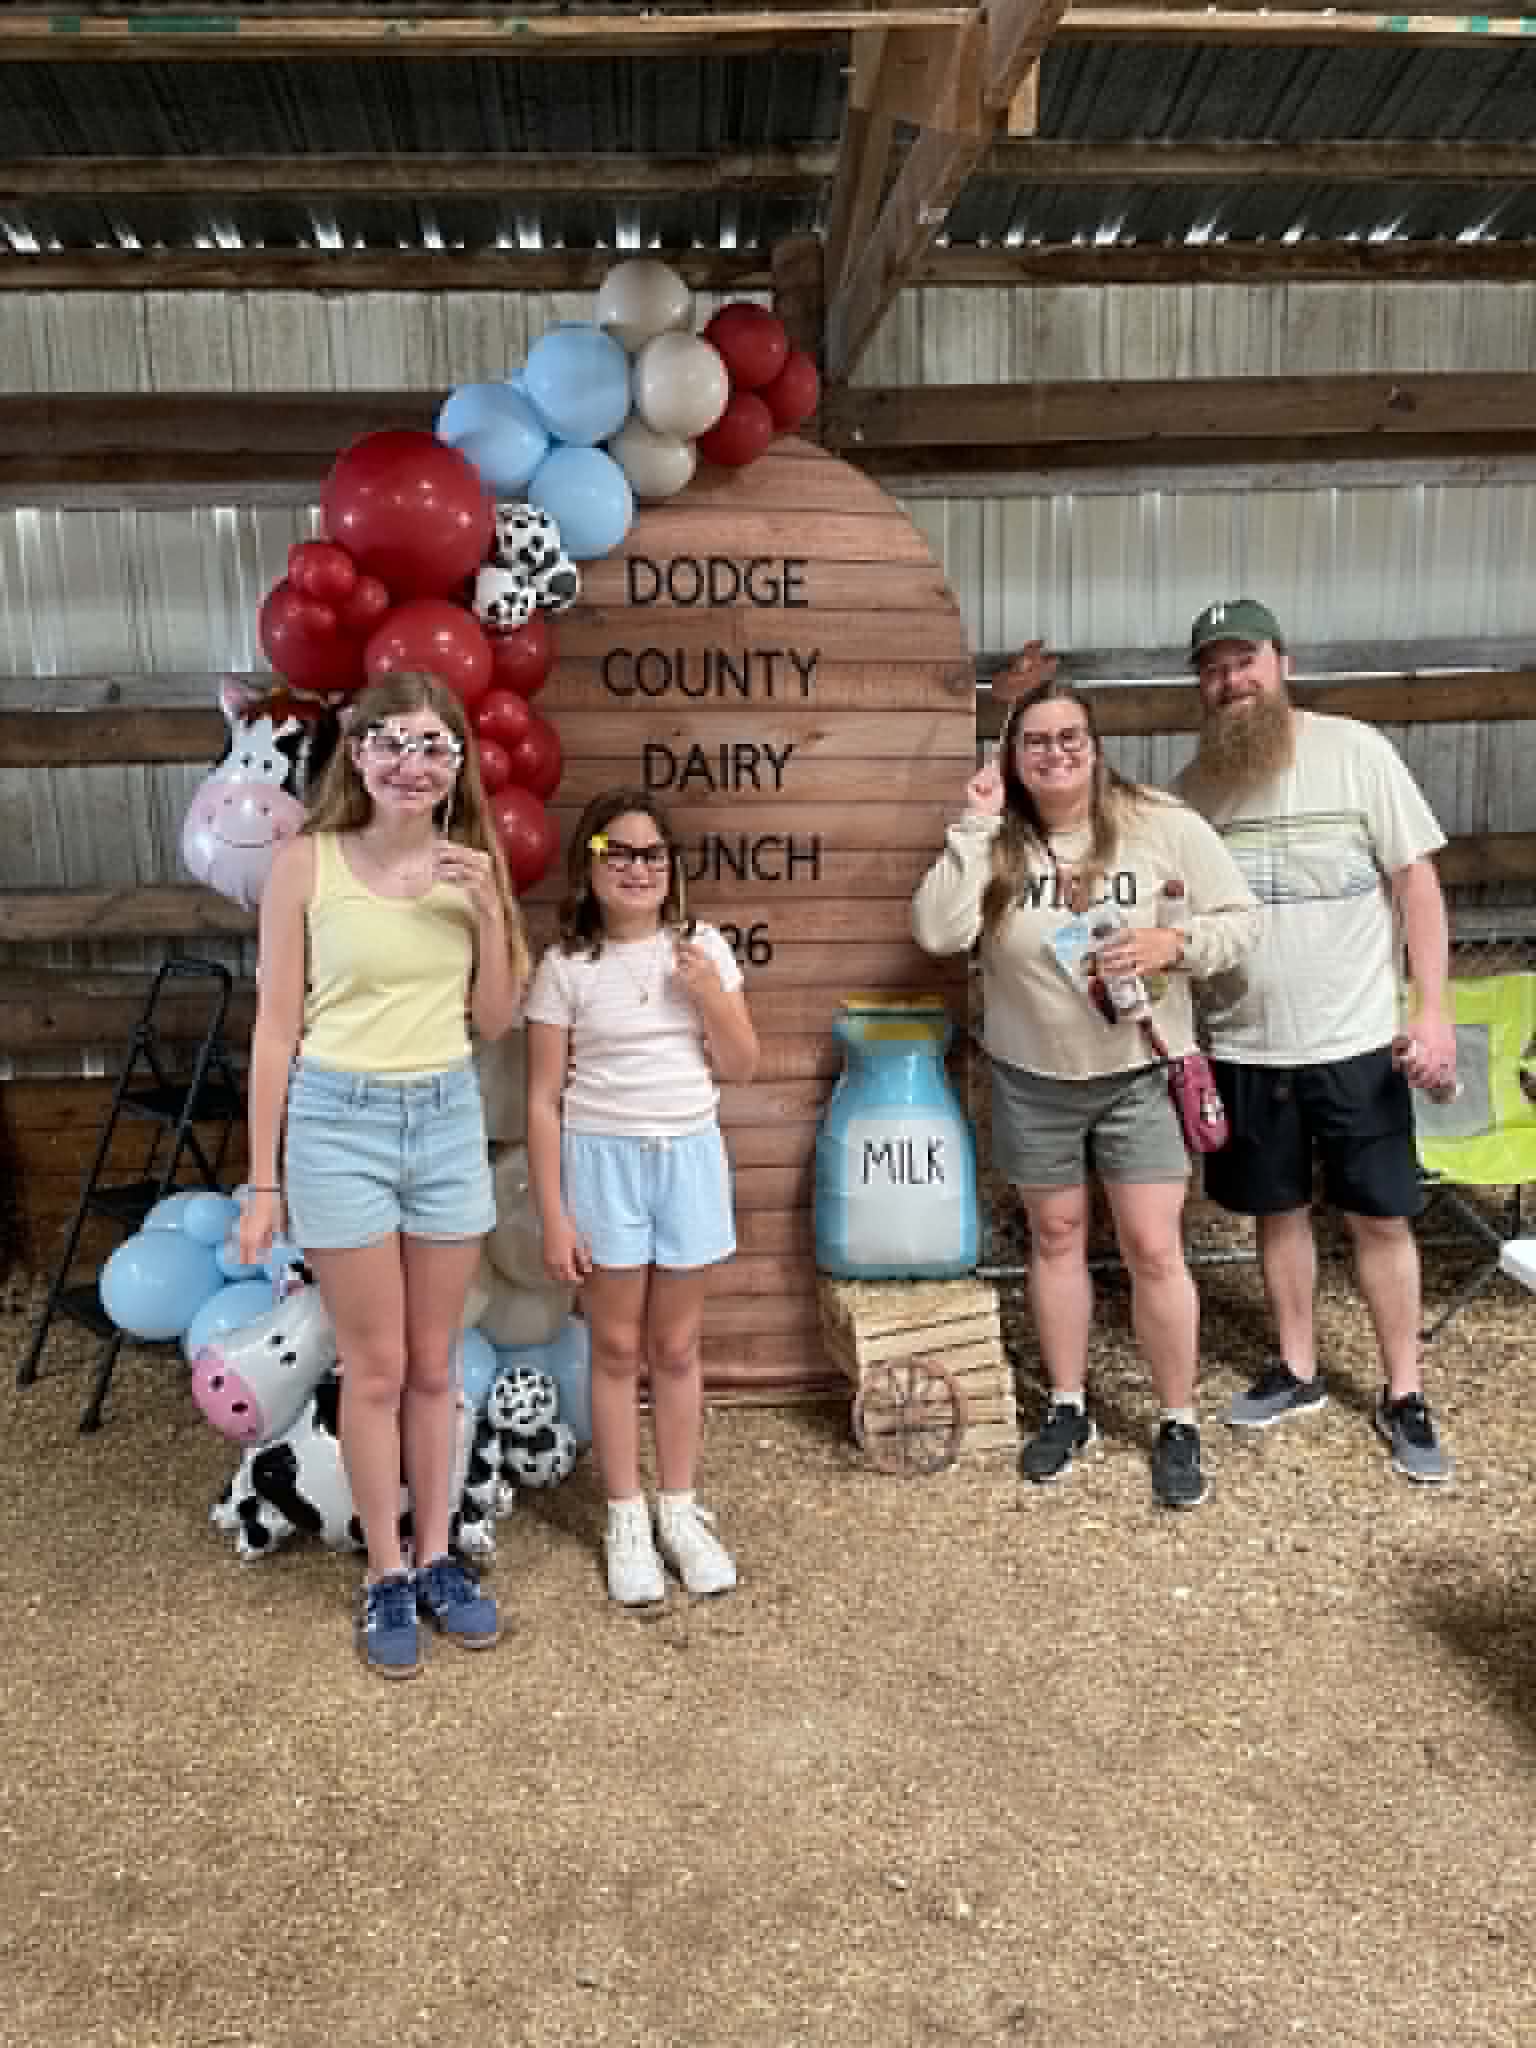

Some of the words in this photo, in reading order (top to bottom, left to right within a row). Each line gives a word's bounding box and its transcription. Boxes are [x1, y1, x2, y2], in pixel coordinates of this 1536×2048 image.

[628, 558, 808, 608] DODGE
[602, 647, 820, 697] COUNTY
[642, 743, 793, 792] DAIRY
[684, 833, 820, 881] UNCH
[719, 921, 774, 967] 26
[863, 1137, 945, 1185] MILK
